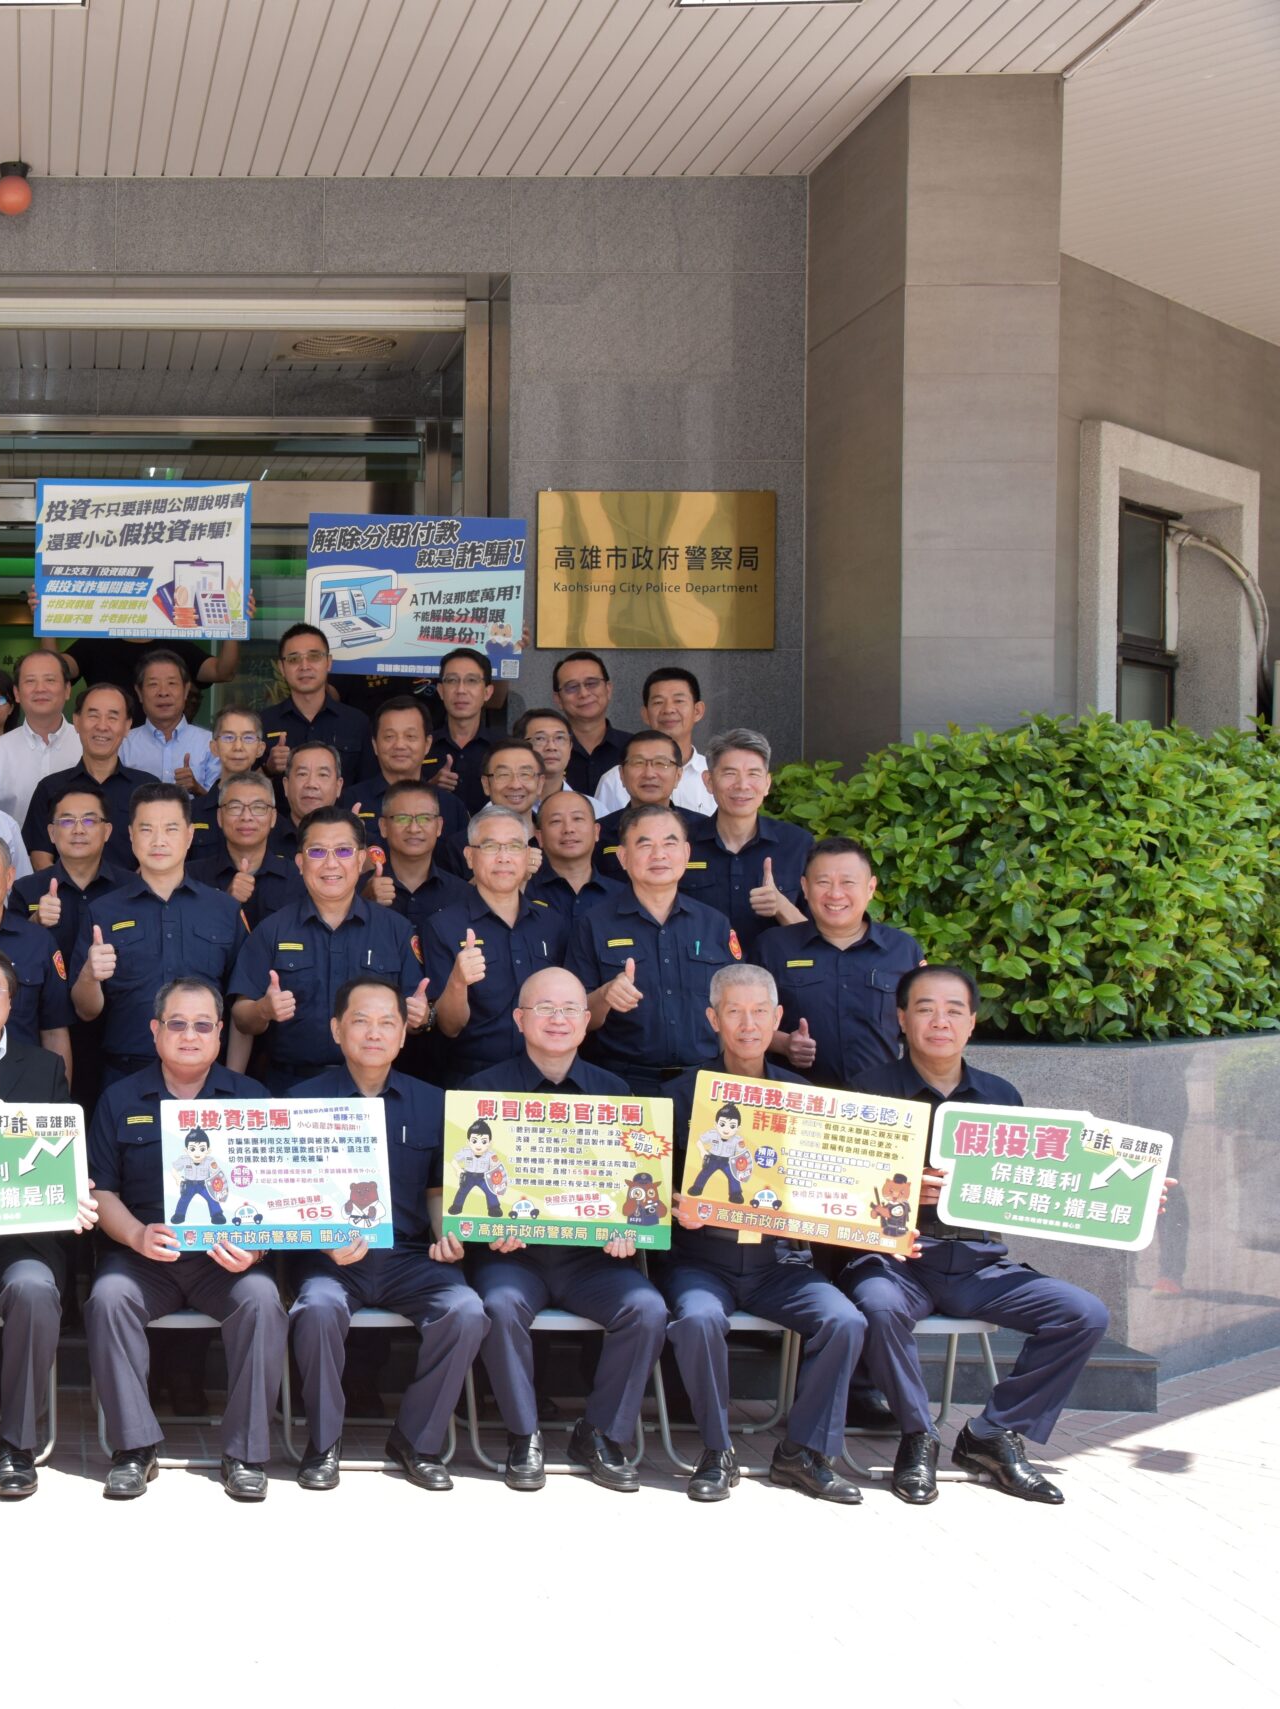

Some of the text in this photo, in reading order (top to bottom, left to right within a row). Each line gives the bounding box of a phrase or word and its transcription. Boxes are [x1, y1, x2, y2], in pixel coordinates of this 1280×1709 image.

[45, 492, 247, 523] 投資不只要詳閱公開說明書
[311, 520, 461, 552] 解除分期付款
[554, 545, 759, 571] 高雄市政府警察局
[553, 582, 758, 595] Kaohsiung City Police Department
[413, 607, 506, 624] 不能解除分期跟
[711, 1081, 837, 1115] 「猜猜我是誰」
[36, 1116, 76, 1128] 高雄隊
[178, 1109, 291, 1130] 假投資詐騙
[477, 1099, 643, 1124] 假冒檢察官詐騙
[752, 1111, 787, 1134] 詐騙
[953, 1121, 1072, 1161] 假投資
[1081, 1129, 1163, 1155] 打詐 高雄隊
[991, 1163, 1081, 1193] 保證獲利
[297, 1206, 333, 1220] 165
[575, 1205, 610, 1216] 165
[821, 1203, 857, 1216] 165
[202, 1229, 313, 1244] 高雄市政府警察局
[478, 1224, 588, 1240] 高雄市政府警察局
[715, 1208, 880, 1245] 高雄市政府警察局 關心您
